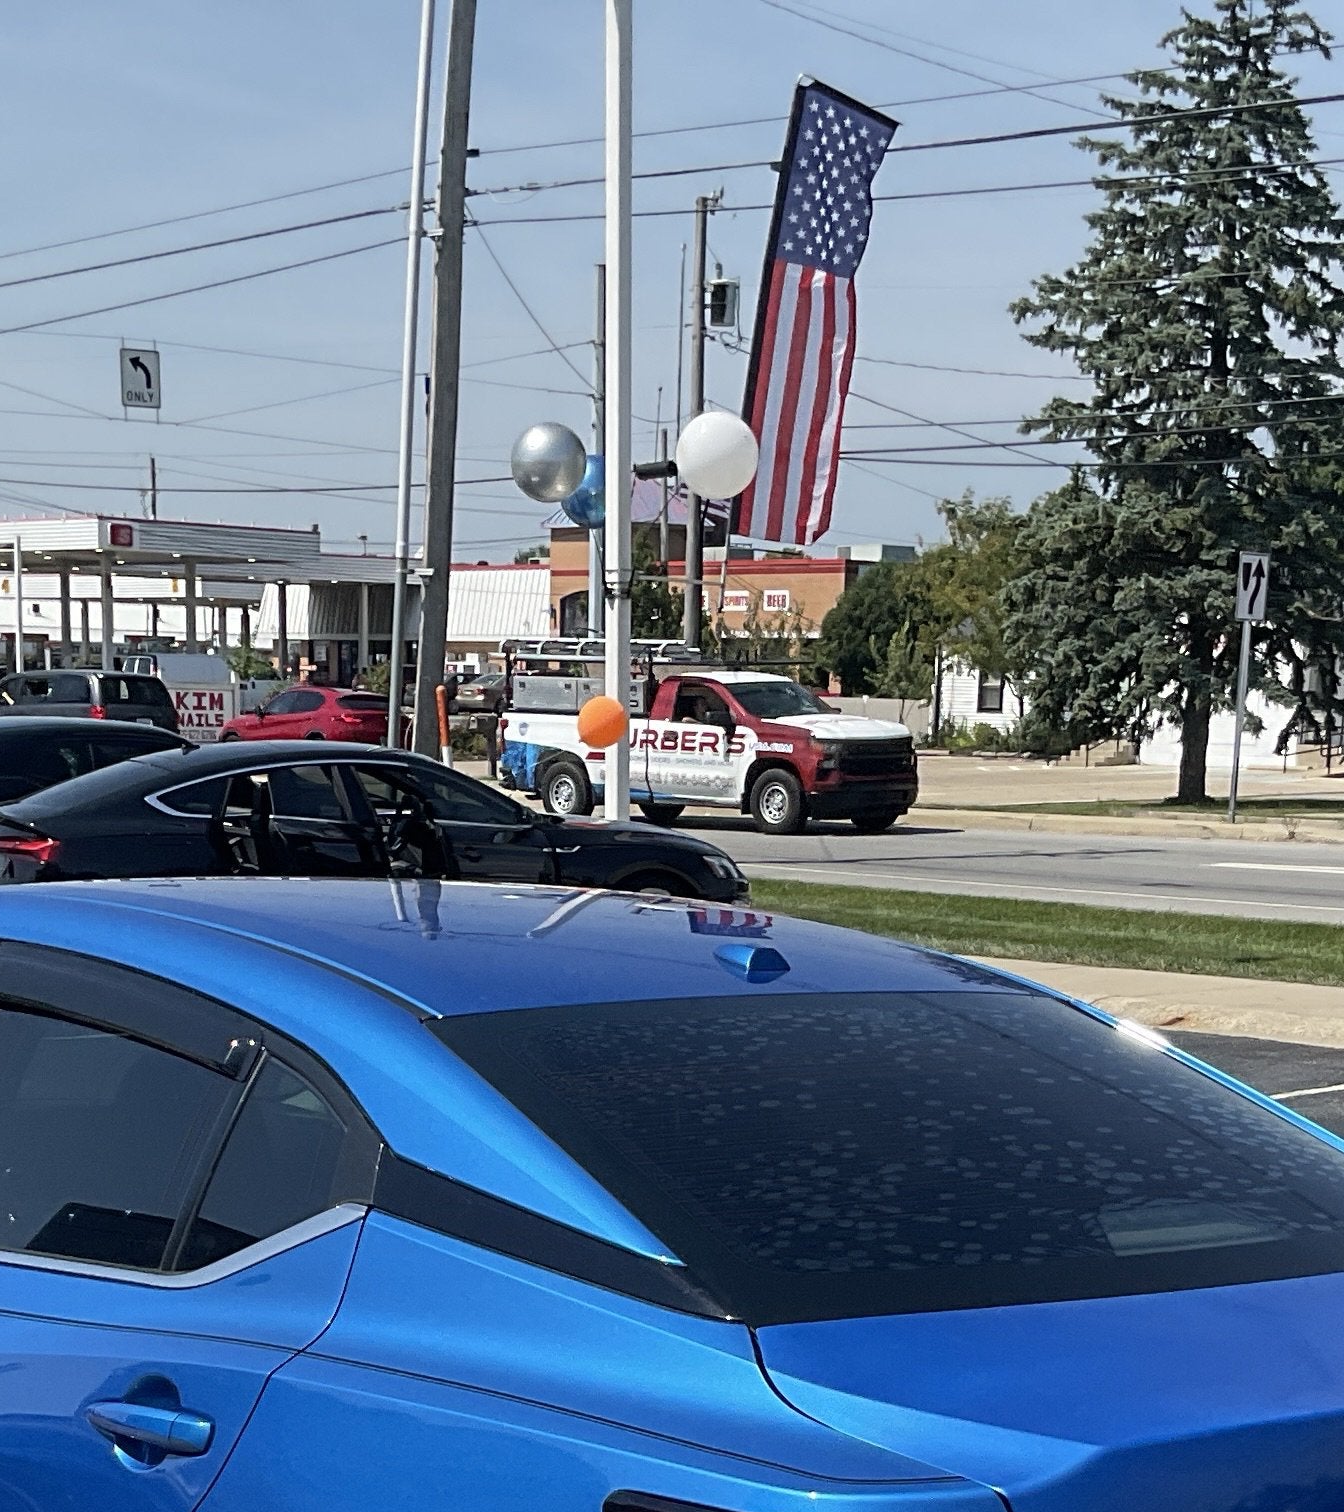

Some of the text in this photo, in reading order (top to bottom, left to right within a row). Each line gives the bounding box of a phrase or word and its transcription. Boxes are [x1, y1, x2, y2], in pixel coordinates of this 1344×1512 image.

[127, 391, 154, 403] ONLY
[176, 691, 224, 711] KIM
[176, 713, 224, 728] NAILS
